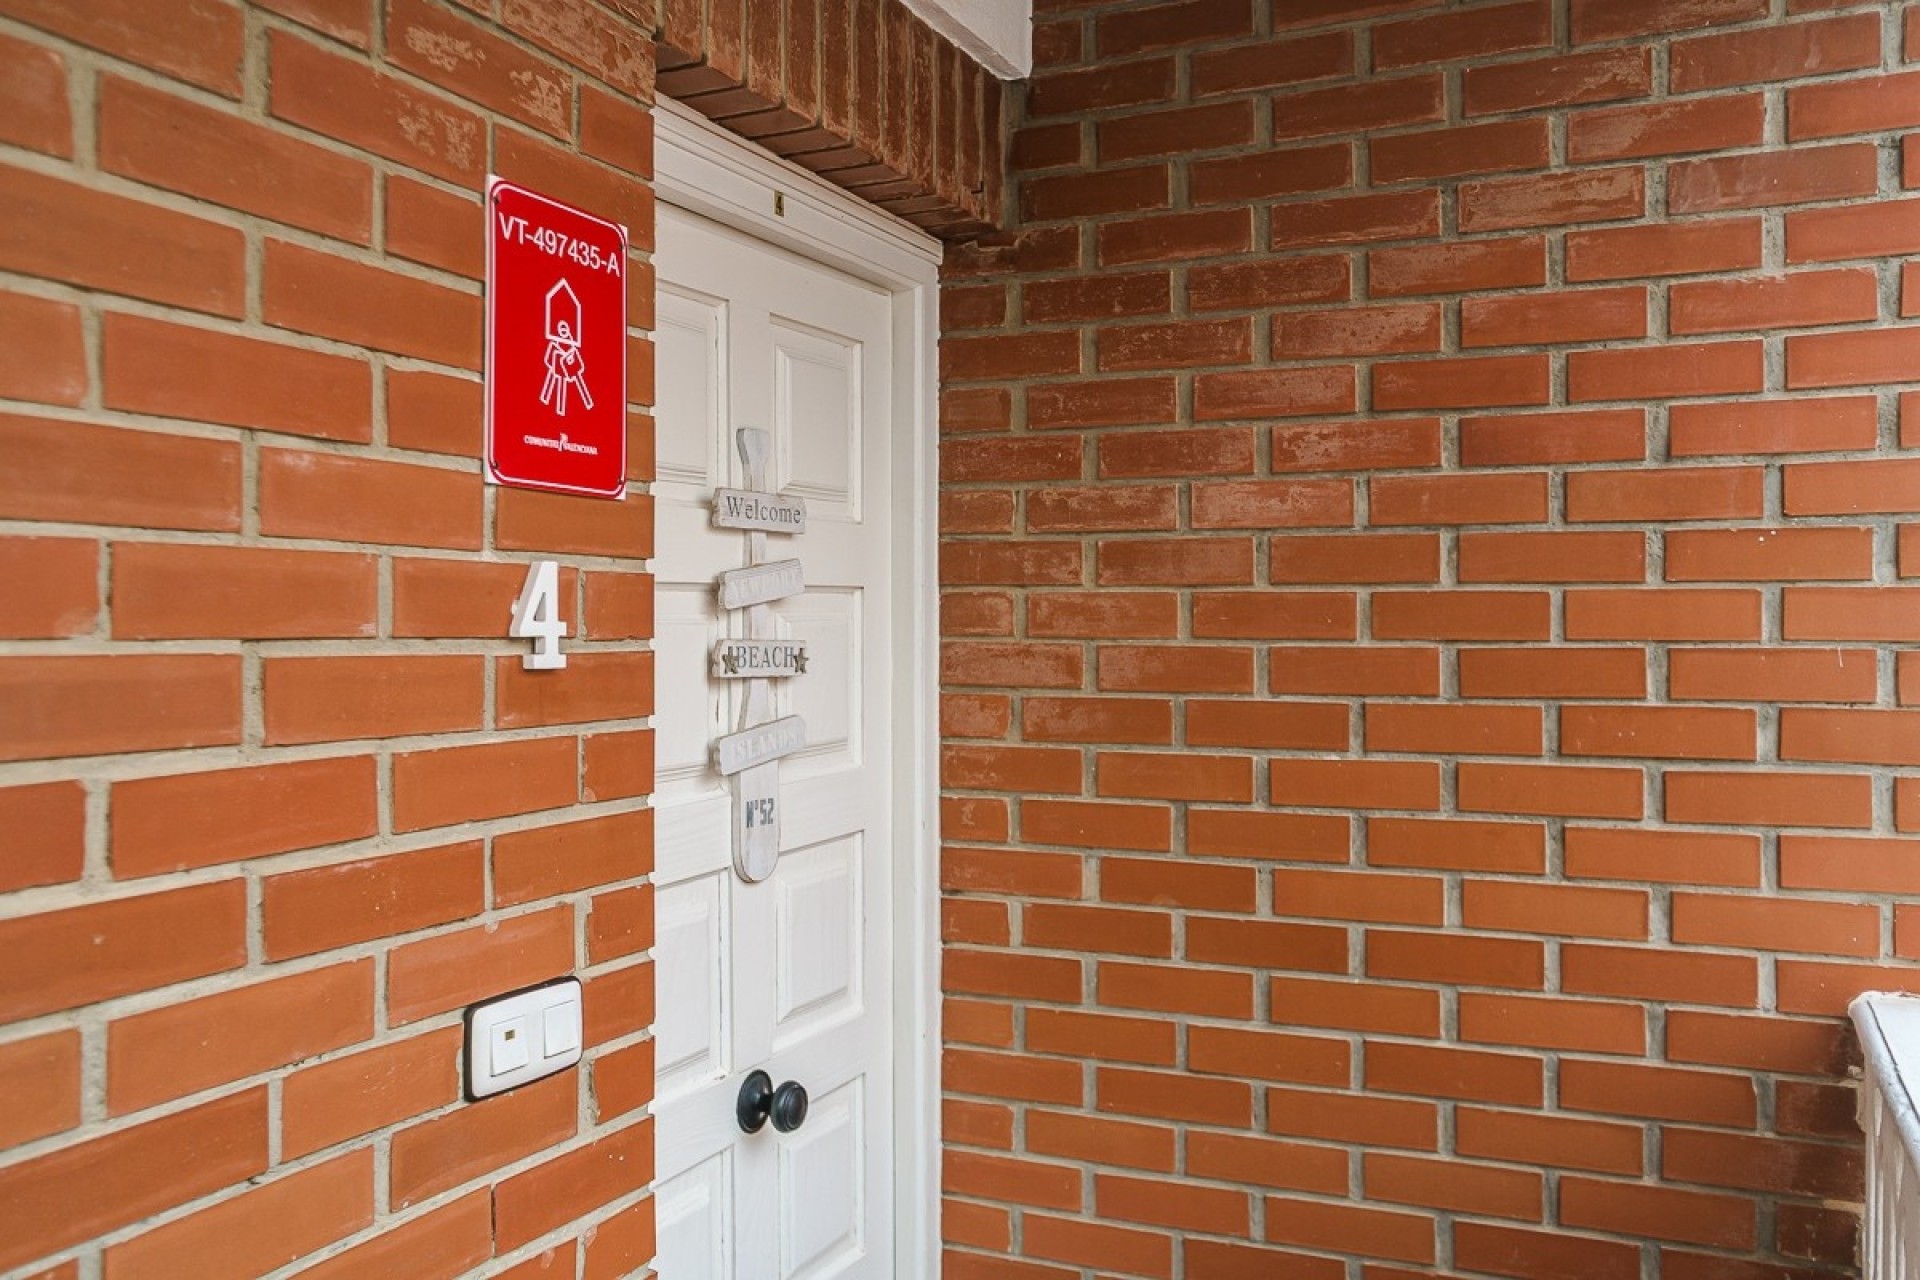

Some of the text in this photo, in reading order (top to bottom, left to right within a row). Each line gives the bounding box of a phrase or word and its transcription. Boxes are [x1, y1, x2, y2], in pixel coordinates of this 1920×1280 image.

[499, 212, 620, 277] VT-497435-A
[726, 496, 801, 523] Welcome
[509, 561, 567, 669] 4
[737, 646, 794, 668] BEACH
